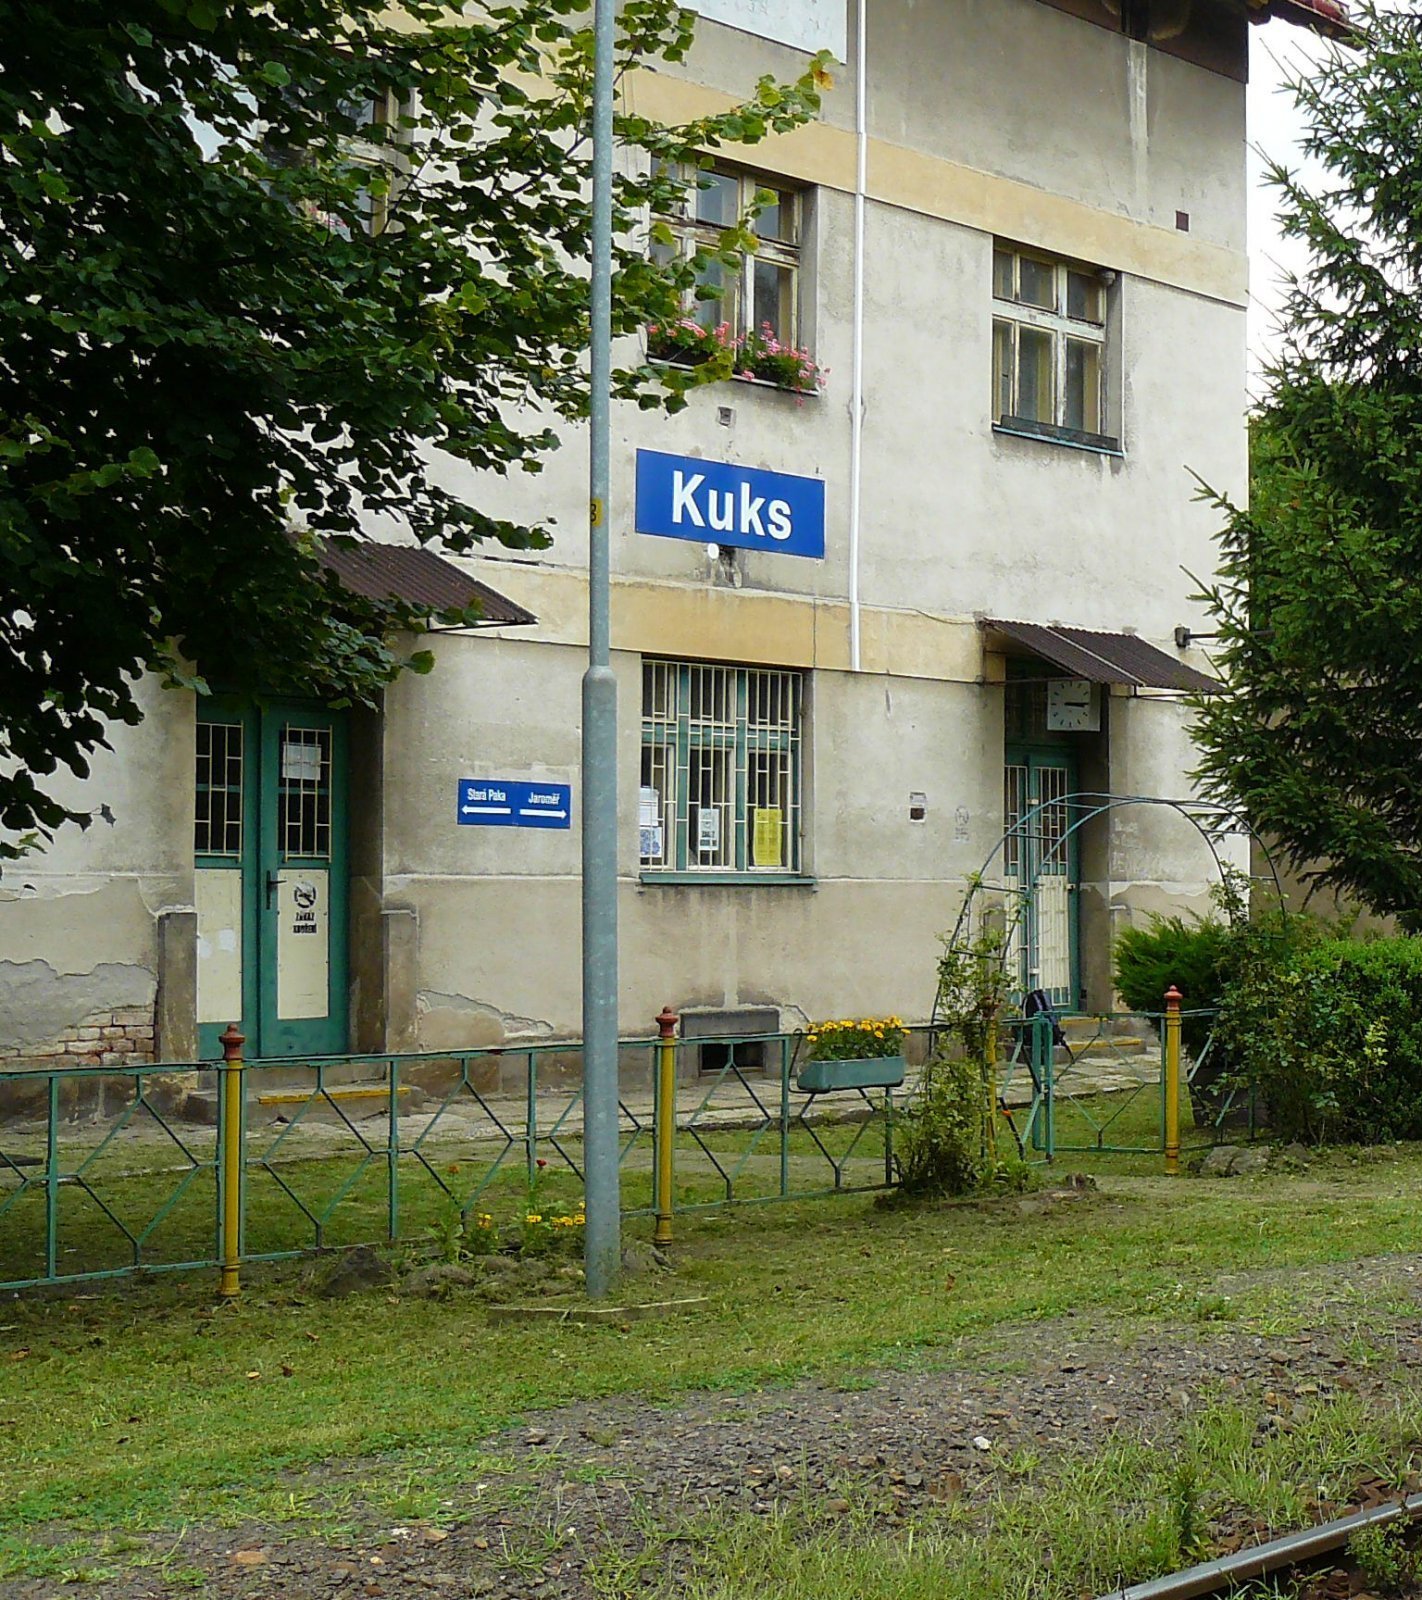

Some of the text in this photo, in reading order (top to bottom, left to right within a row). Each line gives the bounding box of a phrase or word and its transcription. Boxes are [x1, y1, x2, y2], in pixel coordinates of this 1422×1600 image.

[672, 470, 792, 540] Kuks
[467, 788, 506, 802] Stará Paka
[528, 792, 560, 805] Jaroměř
